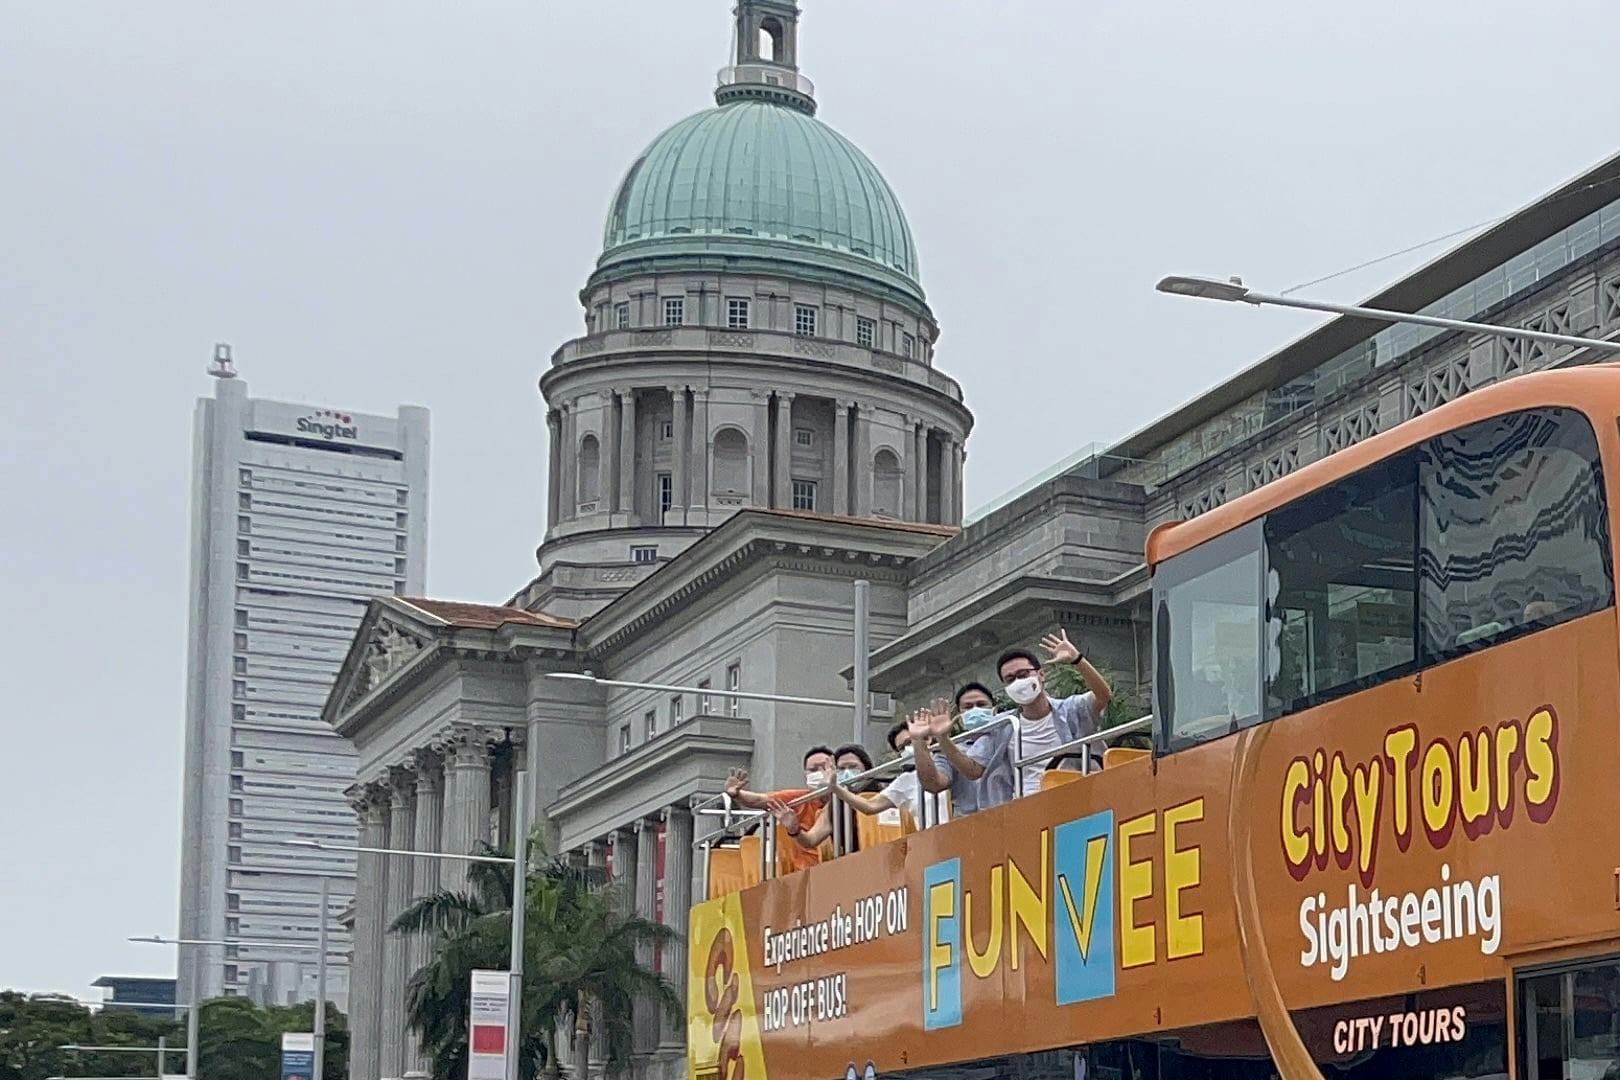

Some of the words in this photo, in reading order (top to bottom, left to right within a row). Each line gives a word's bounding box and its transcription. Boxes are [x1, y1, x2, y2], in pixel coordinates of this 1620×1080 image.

[297, 417, 358, 440] Singtel
[763, 917, 829, 974] Experience
[831, 905, 852, 949] the
[855, 894, 884, 944] HOP
[886, 887, 908, 935] ON
[927, 796, 1204, 1014] FUNVEE
[1300, 863, 1503, 981] Sightseeing
[764, 988, 789, 1031] HOP
[791, 981, 815, 1026] OFF
[818, 974, 847, 1021] BUS!
[1333, 1014, 1385, 1055] CITY
[1389, 1005, 1467, 1049] TOURS
